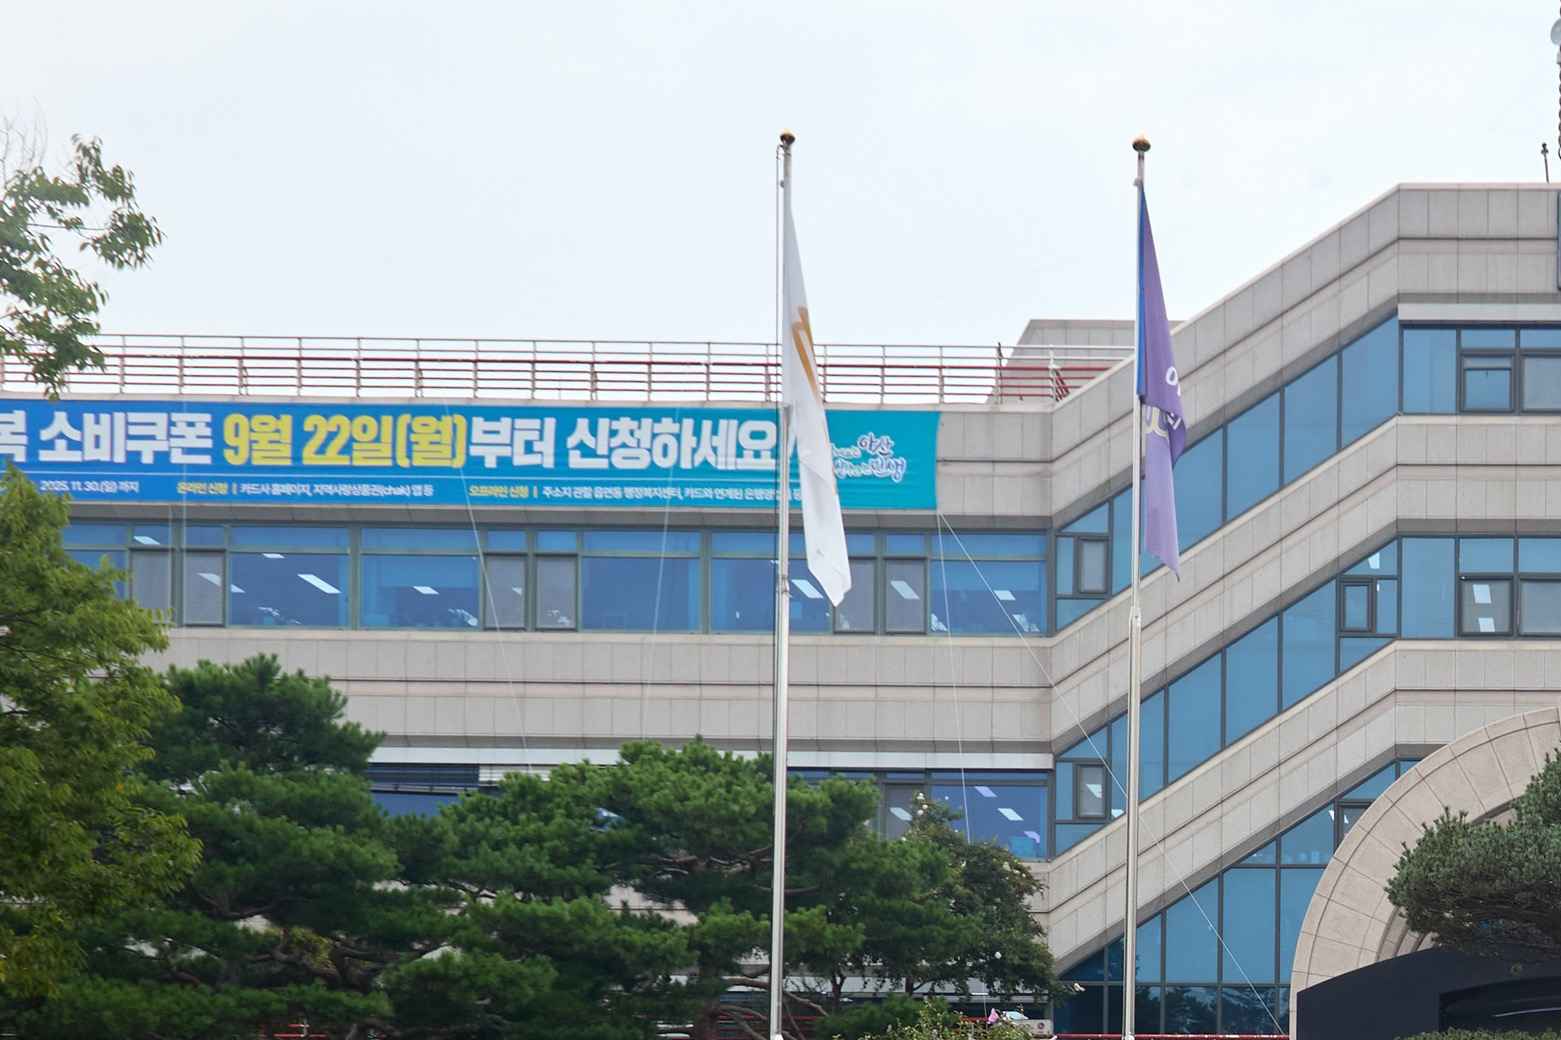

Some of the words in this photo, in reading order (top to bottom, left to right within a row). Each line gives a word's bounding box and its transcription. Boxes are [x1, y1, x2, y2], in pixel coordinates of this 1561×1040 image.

[39, 411, 213, 464] 소비쿠폰
[223, 414, 293, 466] 9월
[566, 417, 778, 471] 신청하세요
